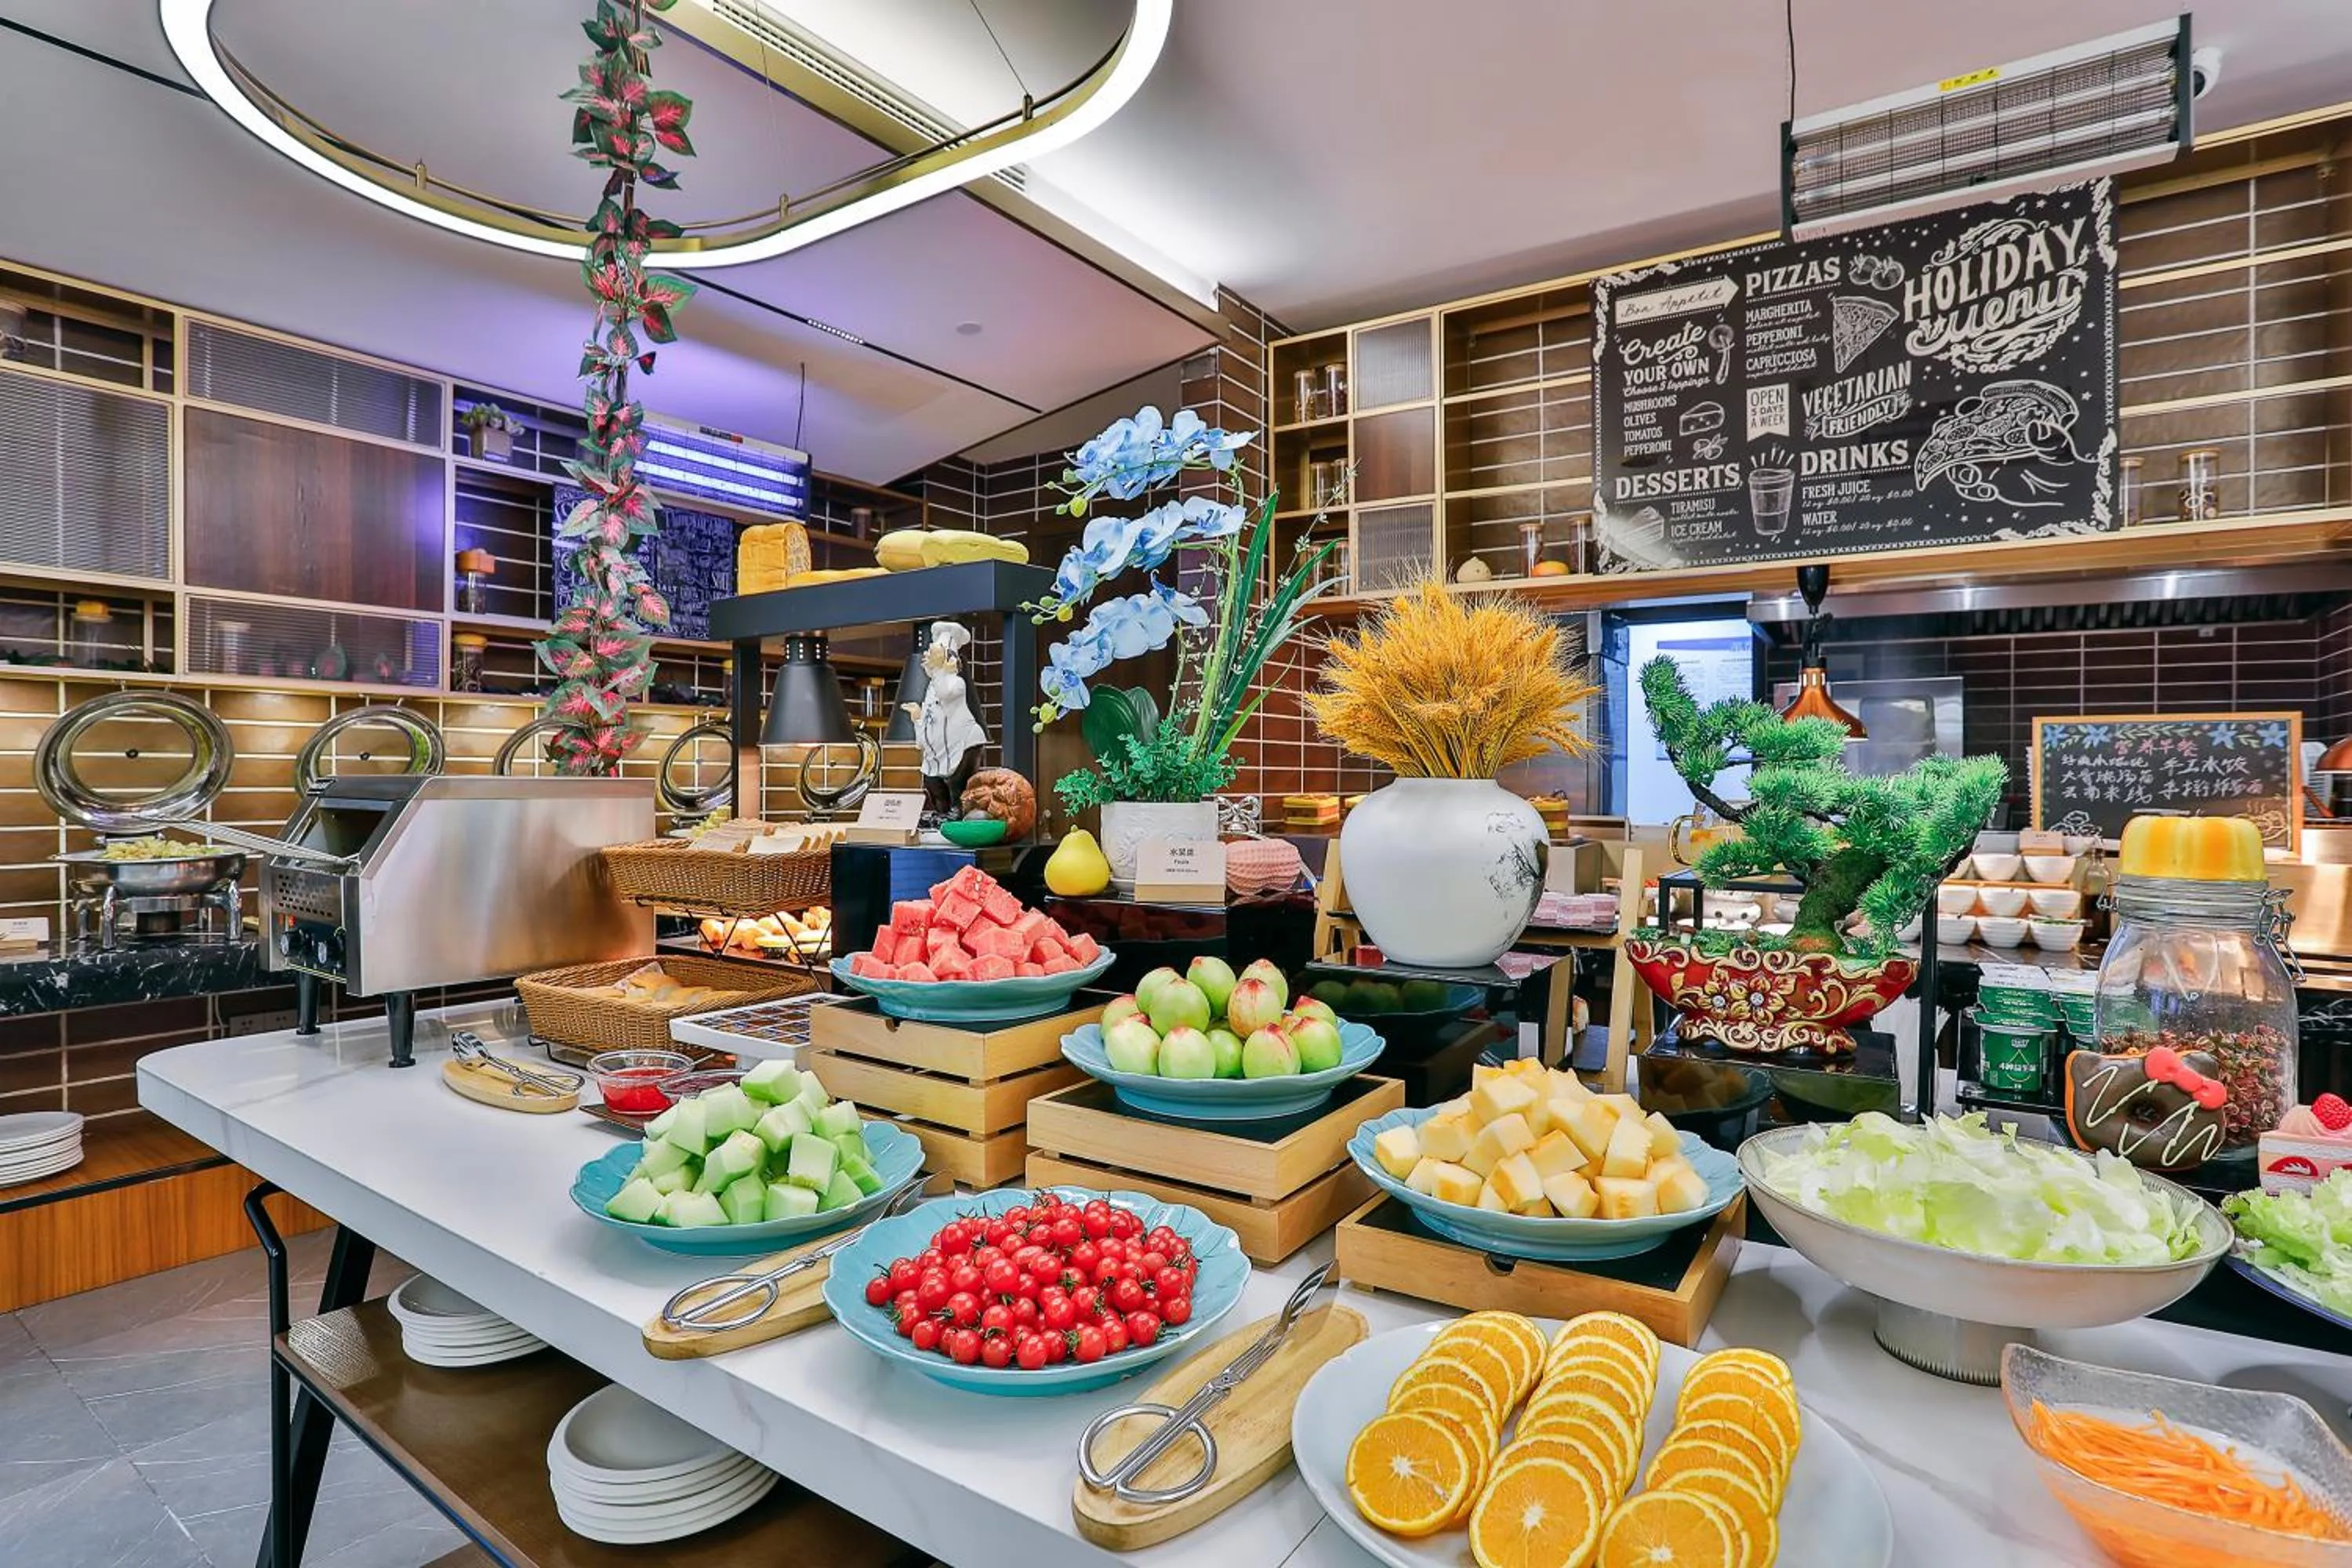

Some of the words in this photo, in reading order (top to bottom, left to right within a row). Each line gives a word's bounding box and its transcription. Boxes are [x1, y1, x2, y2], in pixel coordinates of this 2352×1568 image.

[1745, 256, 1841, 297] PIZZAS
[1904, 216, 2086, 324] HOLIDAY
[1745, 299, 1813, 324] MARGHERITA
[1619, 321, 1707, 365] Create
[1746, 325, 1804, 347] PEPPERONI
[1746, 347, 1817, 372] CAPRICCIOSA
[1623, 365, 1668, 386] YOUR
[1671, 357, 1710, 379] OWN
[1659, 380, 1666, 391] 5
[1802, 360, 1912, 417] VEGETARIAN
[1624, 394, 1678, 414] MUSHROOMS
[1751, 388, 1784, 407] OPEN
[1624, 412, 1657, 428] OLIVES
[1760, 405, 1784, 416] DAYS
[1829, 398, 1892, 436] FRIENDLY
[1751, 419, 1758, 429] A
[1760, 415, 1785, 428] WEEK
[1624, 426, 1663, 442] TOMATOS
[1624, 440, 1672, 458] PEPPERONI
[1800, 438, 1910, 476] DRINKS
[1615, 462, 1740, 499] DESSERTS
[1802, 481, 1835, 499] FRESH
[1837, 479, 1871, 495] JUICE
[1671, 498, 1715, 515] TIRAMISU
[1802, 510, 1837, 527] WATER
[1671, 524, 1688, 538] ICE
[1689, 520, 1723, 535] CREAM
[2158, 755, 2251, 777] 手工水饺
[2061, 785, 2154, 804] 云南米线
